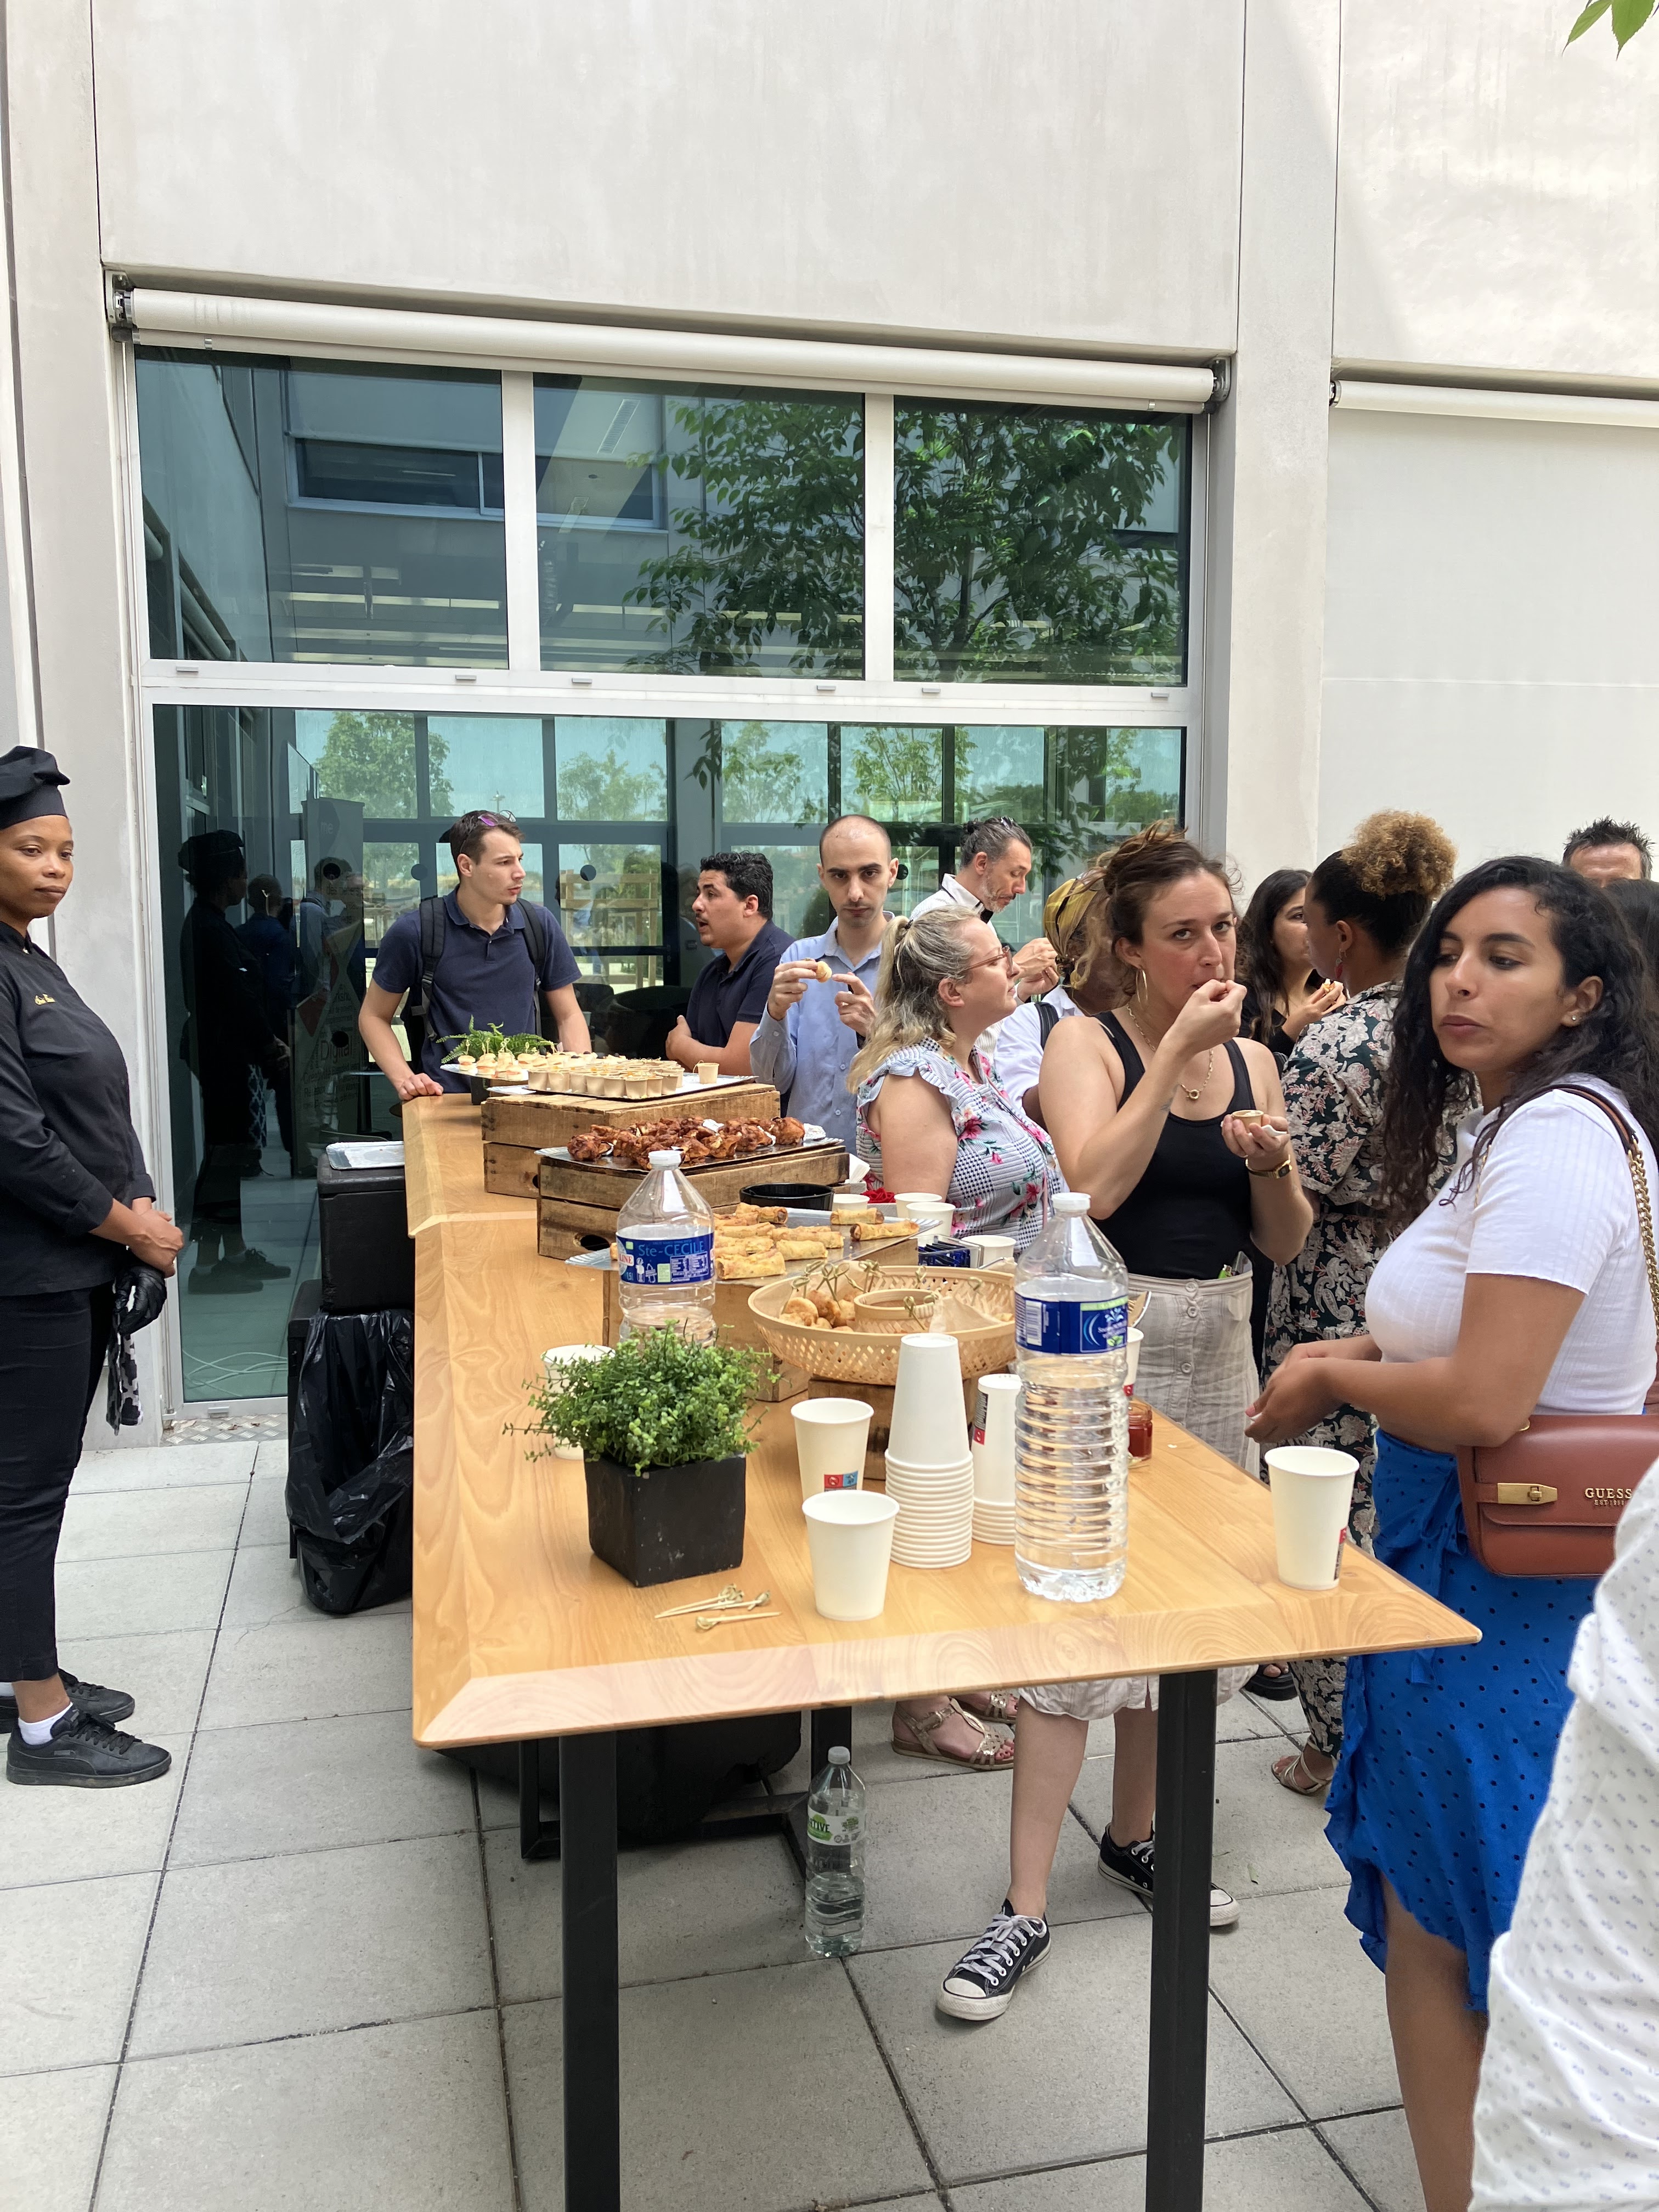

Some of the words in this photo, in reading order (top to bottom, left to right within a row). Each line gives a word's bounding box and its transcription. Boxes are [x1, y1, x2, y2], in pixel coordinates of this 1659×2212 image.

[320, 1036, 352, 1063] Digital
[638, 1240, 705, 1257] Ste-CECILE
[1584, 1487, 1632, 1499] GUESS
